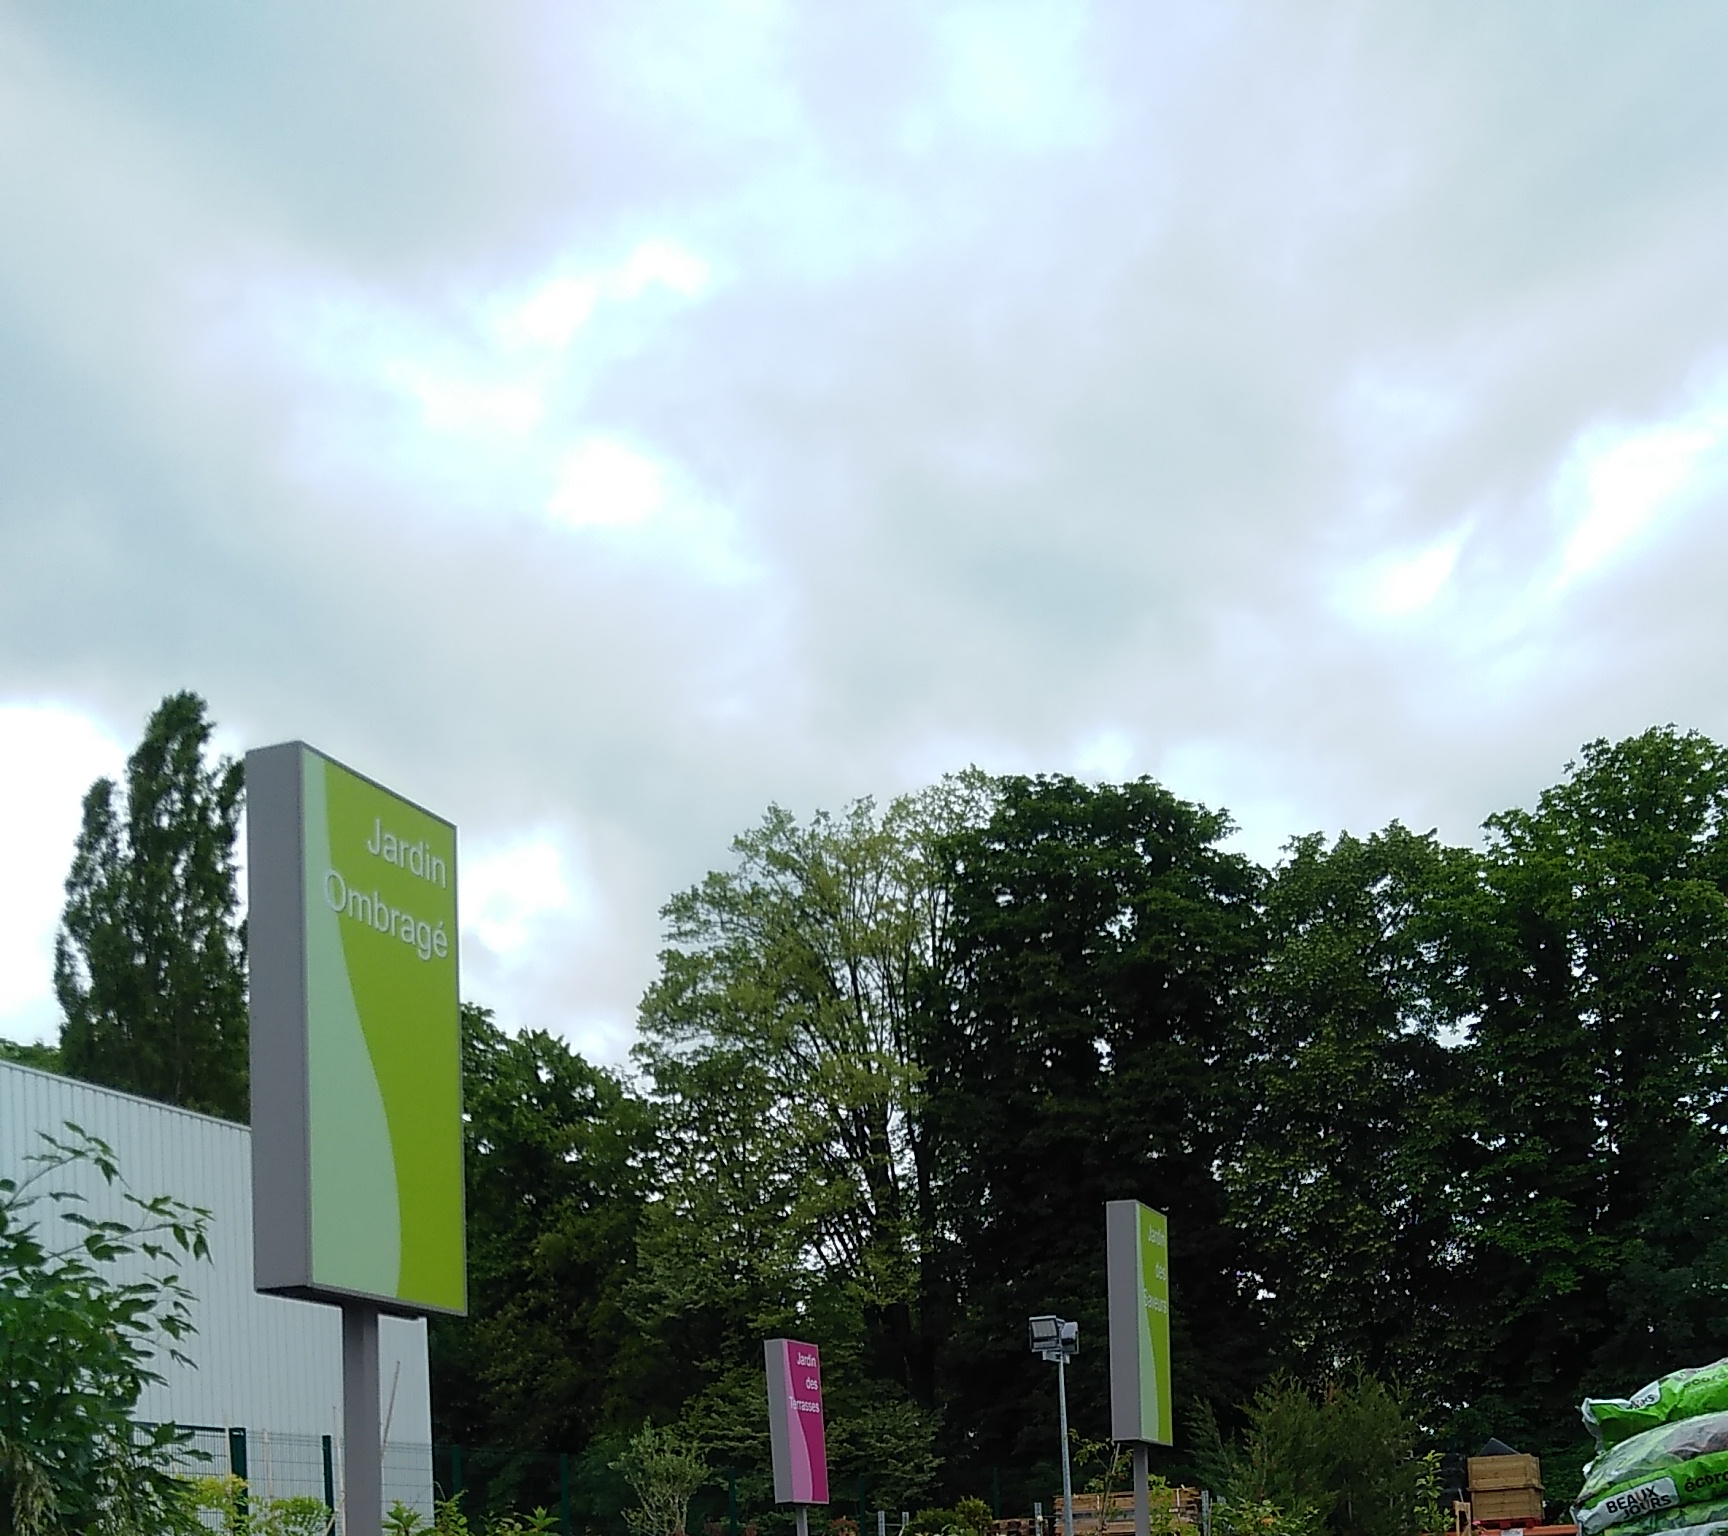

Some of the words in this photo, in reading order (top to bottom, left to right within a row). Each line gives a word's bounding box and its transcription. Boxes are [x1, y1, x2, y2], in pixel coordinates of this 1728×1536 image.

[367, 818, 447, 889] Jardin
[325, 869, 449, 961] Ombragé
[797, 1352, 816, 1367] Jardin
[806, 1377, 818, 1390] des
[789, 1397, 820, 1413] Terrasses
[1605, 1485, 1659, 1514] BEAUX
[1623, 1494, 1672, 1519] JOURS
